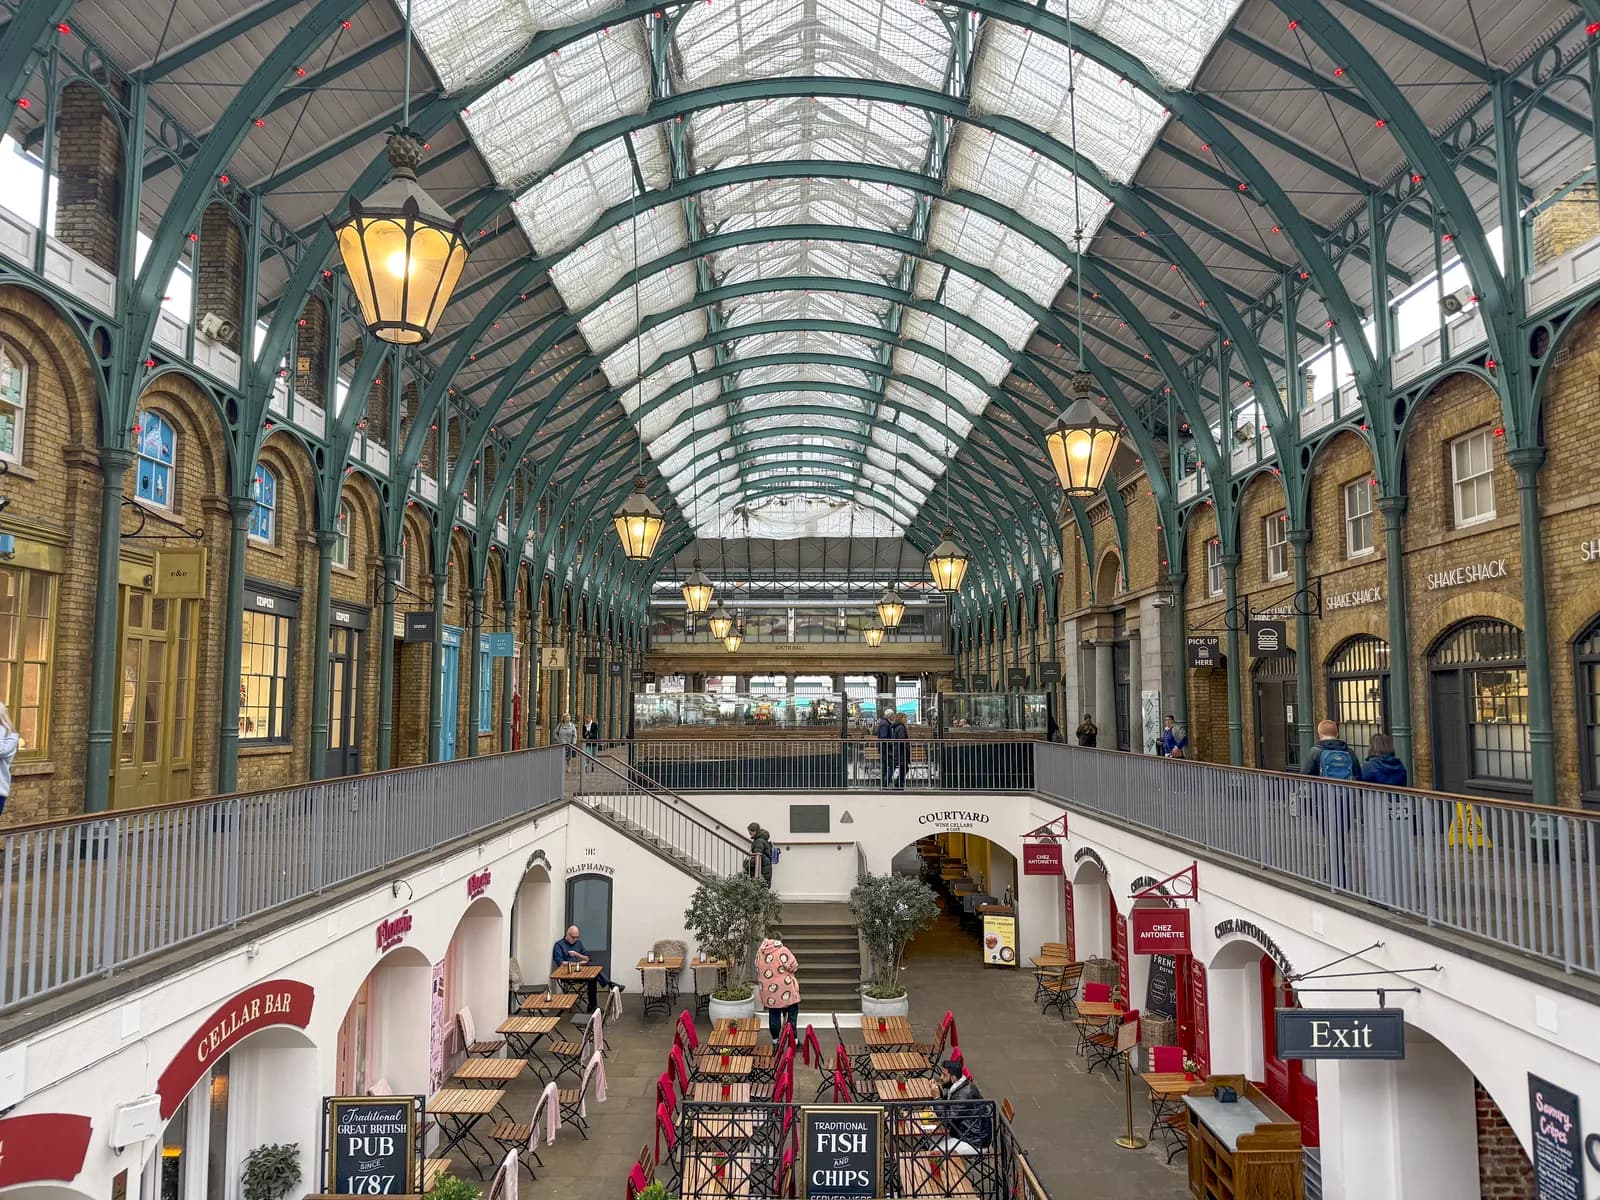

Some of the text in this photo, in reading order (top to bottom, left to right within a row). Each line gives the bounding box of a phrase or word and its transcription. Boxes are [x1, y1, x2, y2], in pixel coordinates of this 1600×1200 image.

[918, 810, 990, 824] COURTYARD
[1214, 919, 1234, 939] CHEZ
[1153, 954, 1176, 968] FRENC
[198, 993, 292, 1062] CELLAR BAR
[1310, 1020, 1373, 1048] Exit
[342, 1108, 402, 1124] Traditional
[338, 1124, 407, 1134] GREAT BRITISH
[814, 1122, 868, 1130] TRADITIONAL
[348, 1137, 394, 1156] PUB
[817, 1133, 867, 1152] FISH
[360, 1160, 380, 1170] SINCE
[834, 1157, 849, 1166] AND
[347, 1174, 395, 1195] 1787
[812, 1170, 869, 1187] CHIPS
